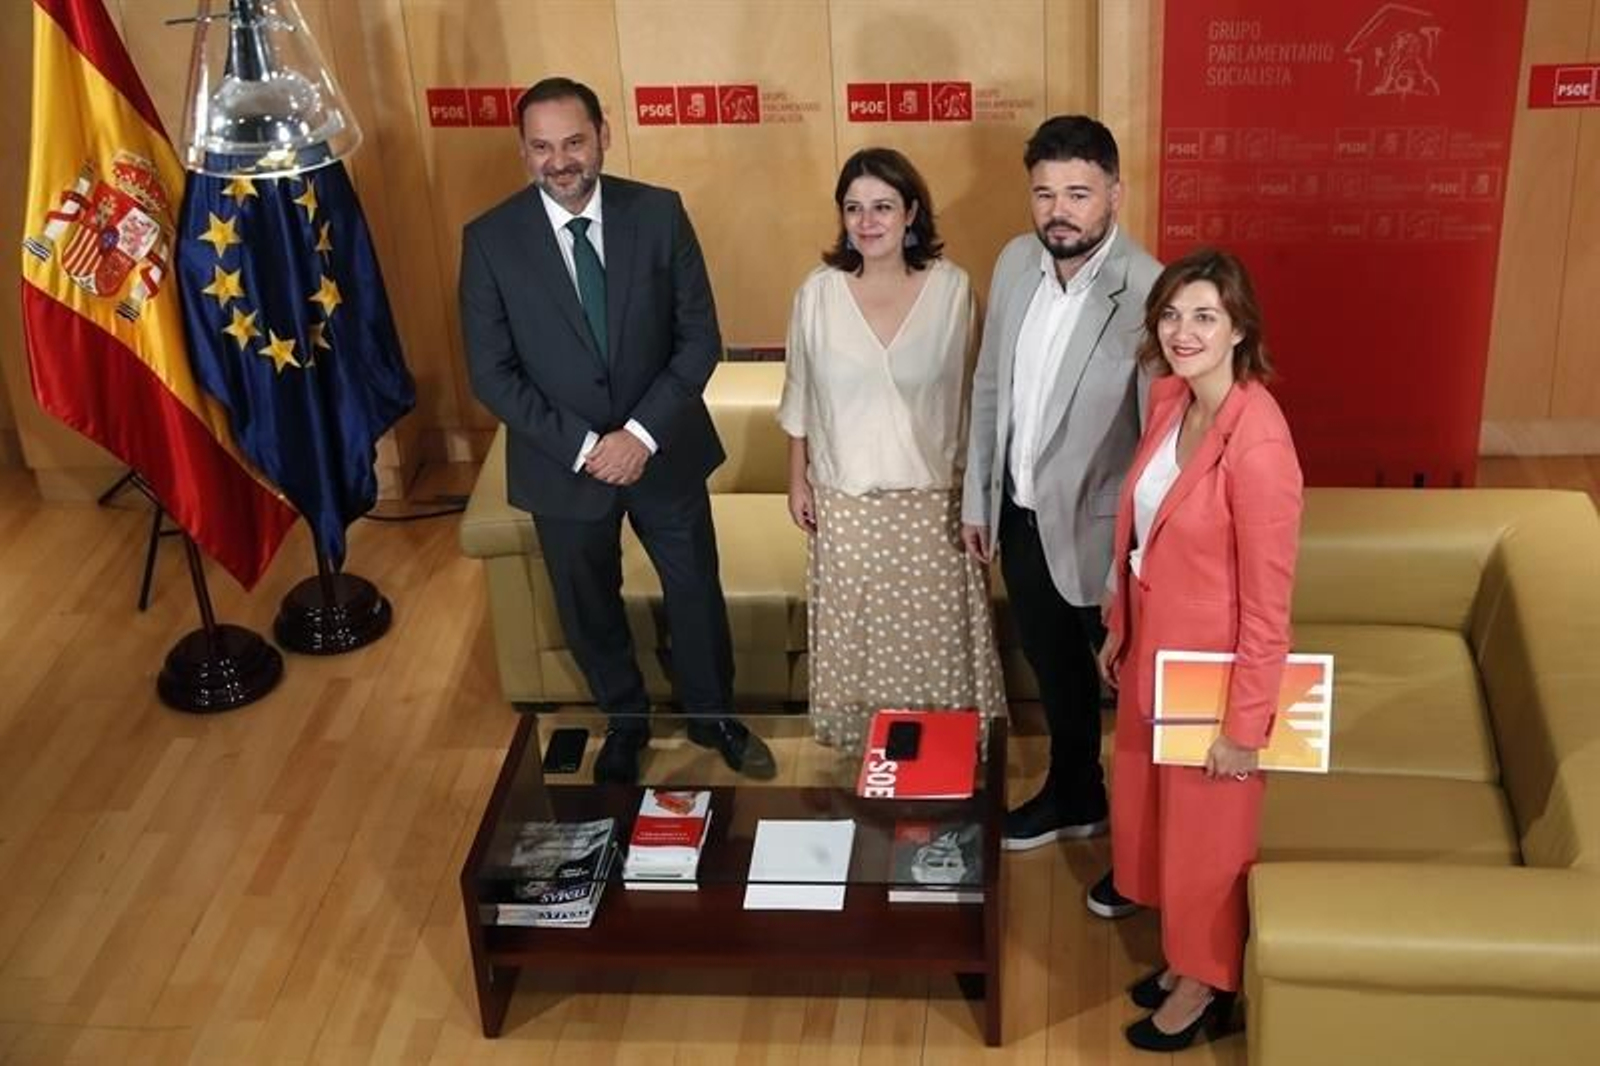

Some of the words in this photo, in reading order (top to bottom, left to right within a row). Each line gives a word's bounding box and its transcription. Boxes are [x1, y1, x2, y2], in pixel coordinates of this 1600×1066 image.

[1208, 21, 1261, 40] GRUPO
[1208, 44, 1334, 63] PARLAMENTARIO
[1207, 66, 1292, 86] SOCIALISTA
[1557, 83, 1591, 97] PSOE
[431, 105, 466, 119] PSOE
[639, 104, 674, 118] PSOE
[850, 101, 886, 114] PSOE
[1168, 142, 1199, 154] PSOE
